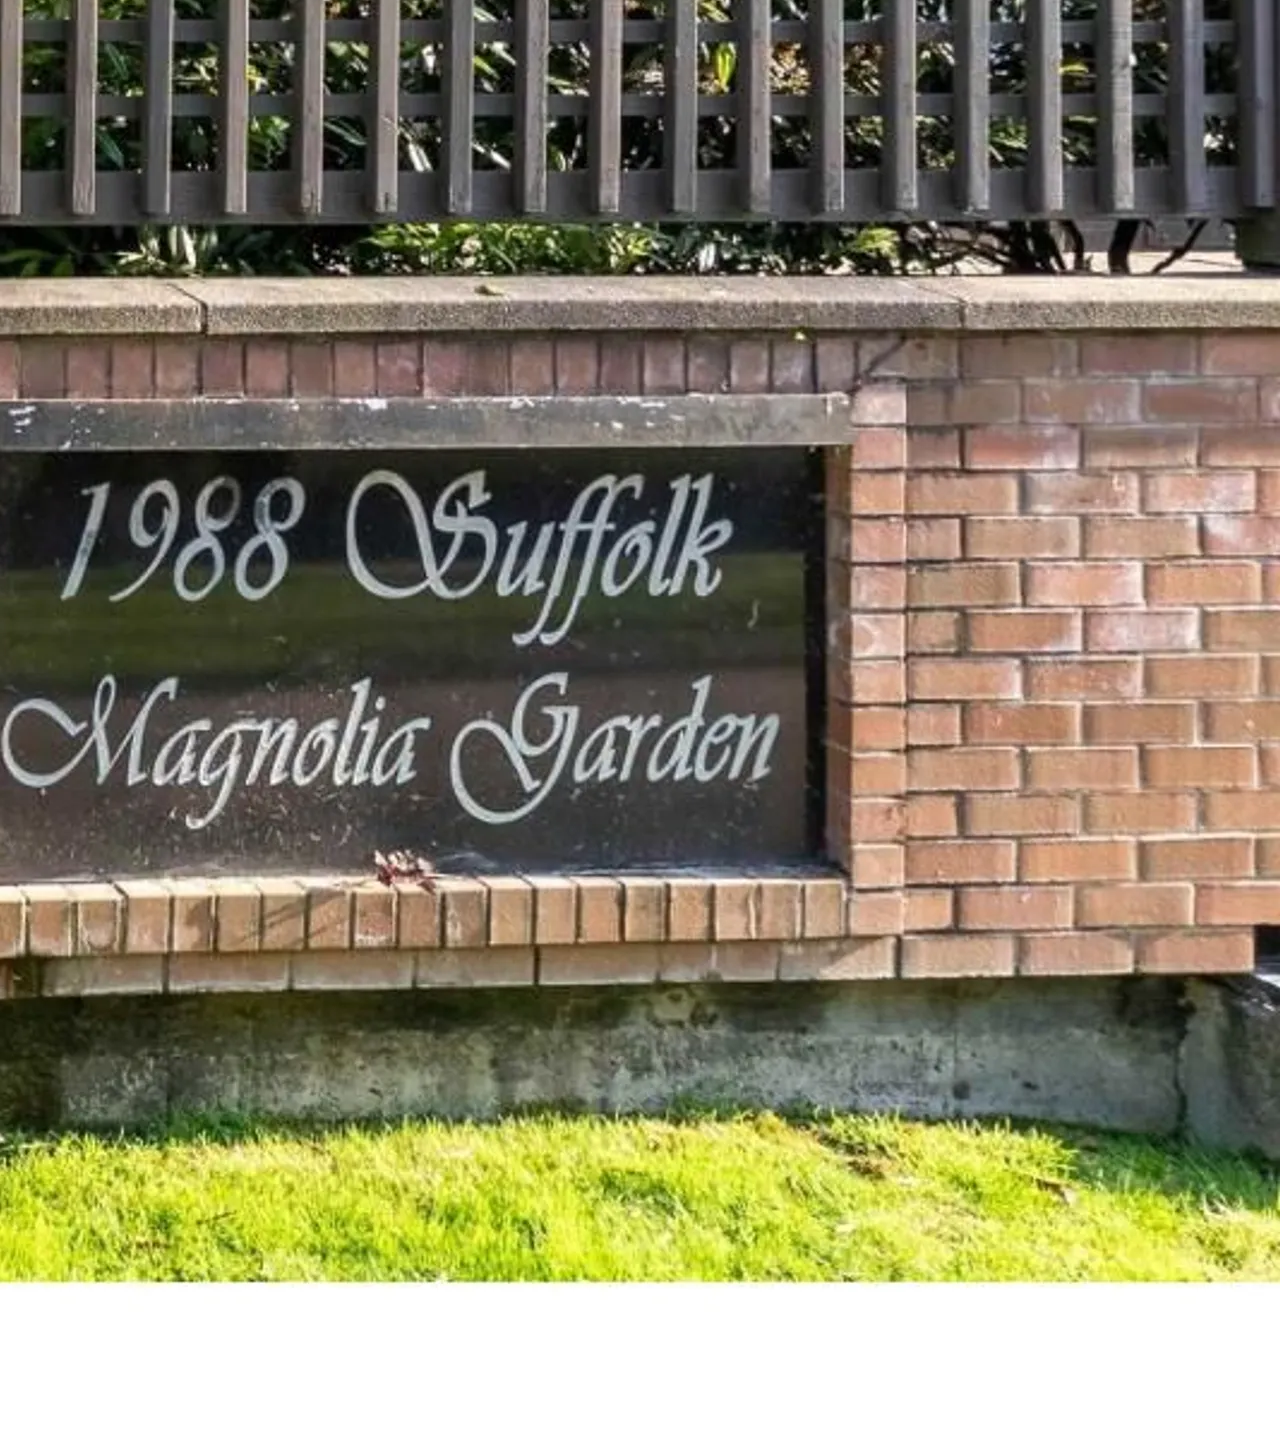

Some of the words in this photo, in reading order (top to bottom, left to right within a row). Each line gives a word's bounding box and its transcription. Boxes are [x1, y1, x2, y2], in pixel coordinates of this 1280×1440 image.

[60, 476, 306, 602] 1988
[345, 469, 733, 646] Suffolk
[1, 674, 431, 830] Magnolia
[450, 671, 780, 824] Garden
